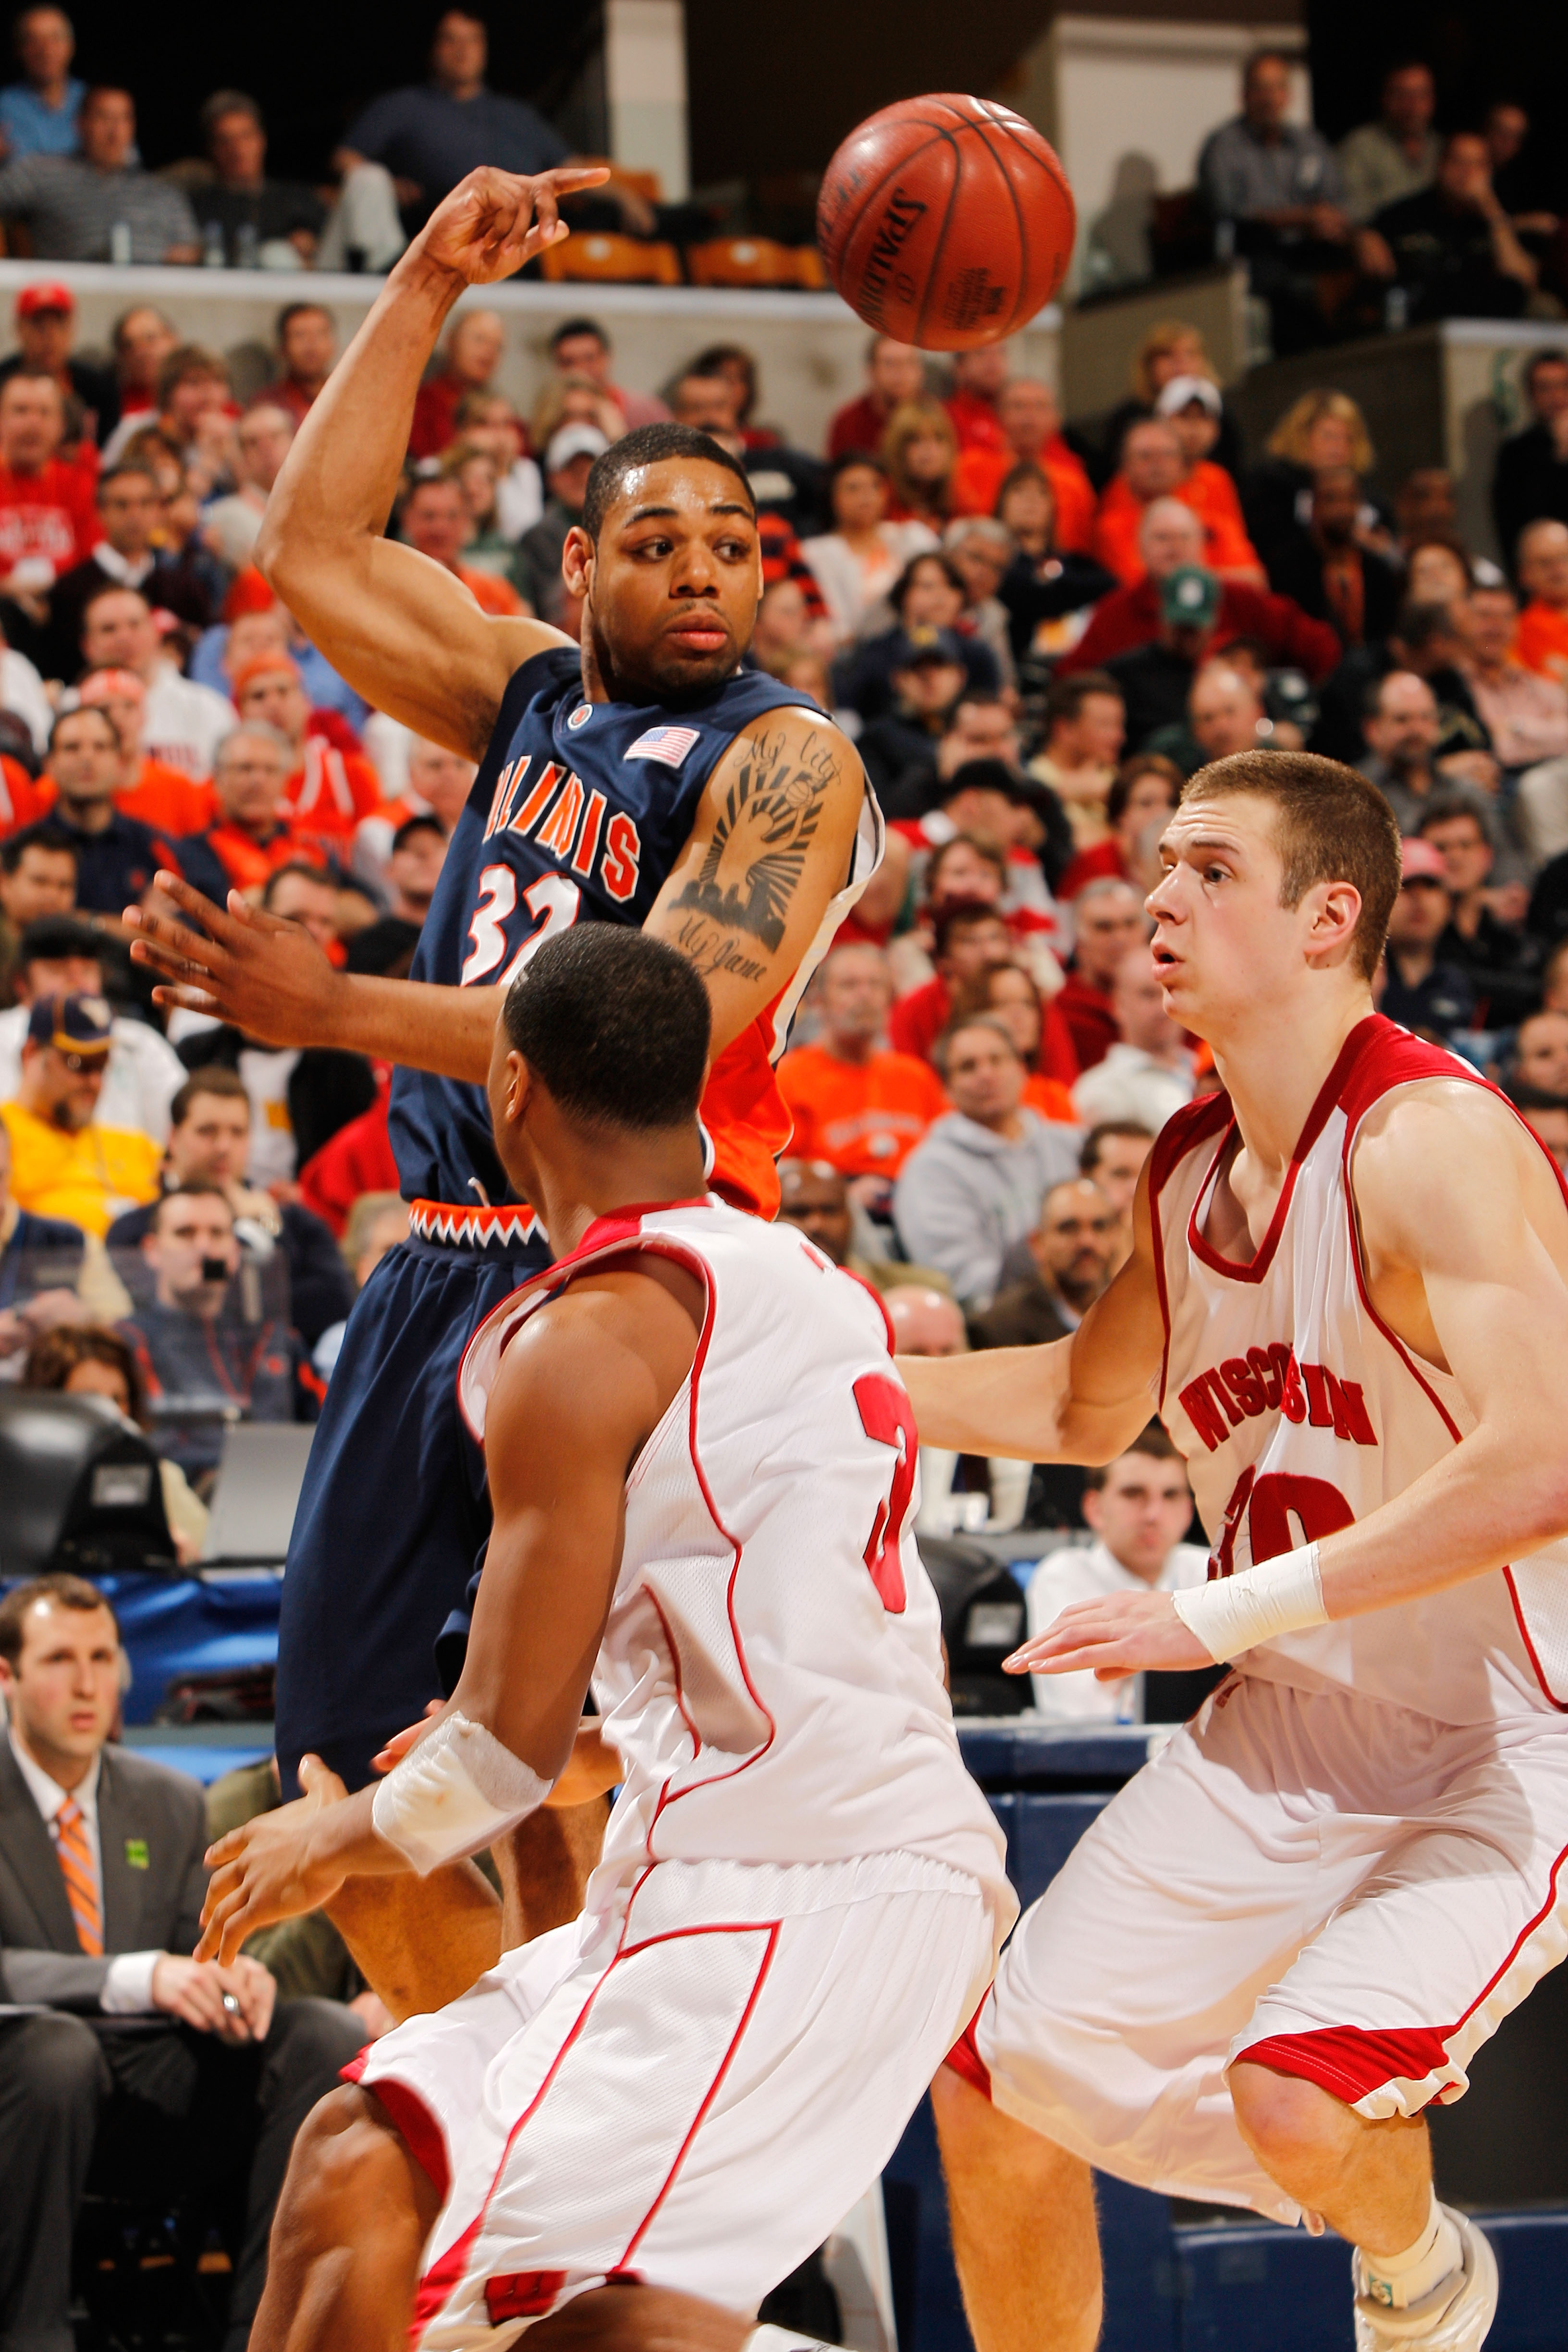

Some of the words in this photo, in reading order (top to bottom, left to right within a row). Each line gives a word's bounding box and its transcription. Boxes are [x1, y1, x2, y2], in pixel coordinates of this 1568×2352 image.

[733, 729, 786, 772] My
[799, 730, 844, 793] City
[460, 863, 581, 988] 32
[670, 915, 720, 961] My
[1178, 1342, 1378, 1452] WISCOSIN
